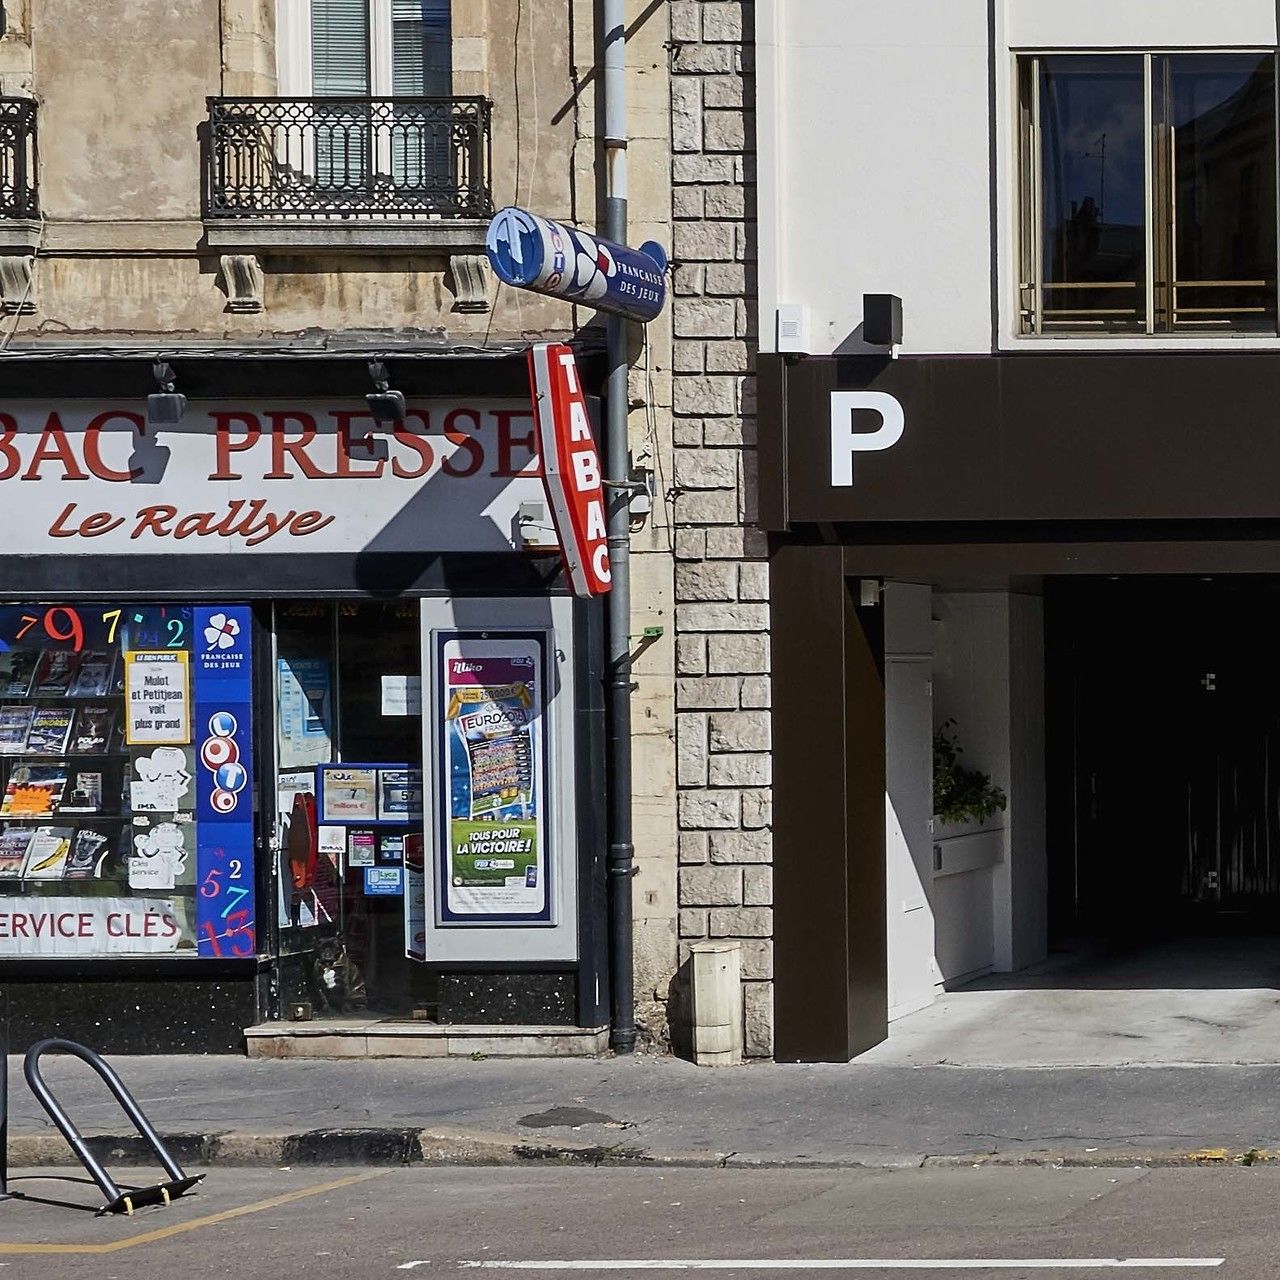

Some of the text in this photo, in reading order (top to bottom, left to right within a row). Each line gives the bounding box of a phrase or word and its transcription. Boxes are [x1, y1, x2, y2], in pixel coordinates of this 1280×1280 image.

[619, 281, 660, 304] DES JEUX
[207, 408, 542, 481] PRESSE
[830, 391, 905, 486] P
[559, 353, 612, 584] TABAC
[48, 498, 336, 547] Le Rallye
[43, 606, 85, 653] 9
[102, 609, 122, 644] 7
[166, 619, 185, 647] 2
[222, 661, 241, 669] JEUX
[144, 676, 170, 686] Mulot
[131, 690, 183, 703] et Petitjean
[149, 704, 166, 715] voit
[134, 719, 181, 730] plus grand
[469, 828, 521, 841] TOUS POUR
[456, 843, 469, 855] LA
[228, 859, 242, 879] 2
[200, 869, 224, 898] 5
[220, 886, 250, 918] 7
